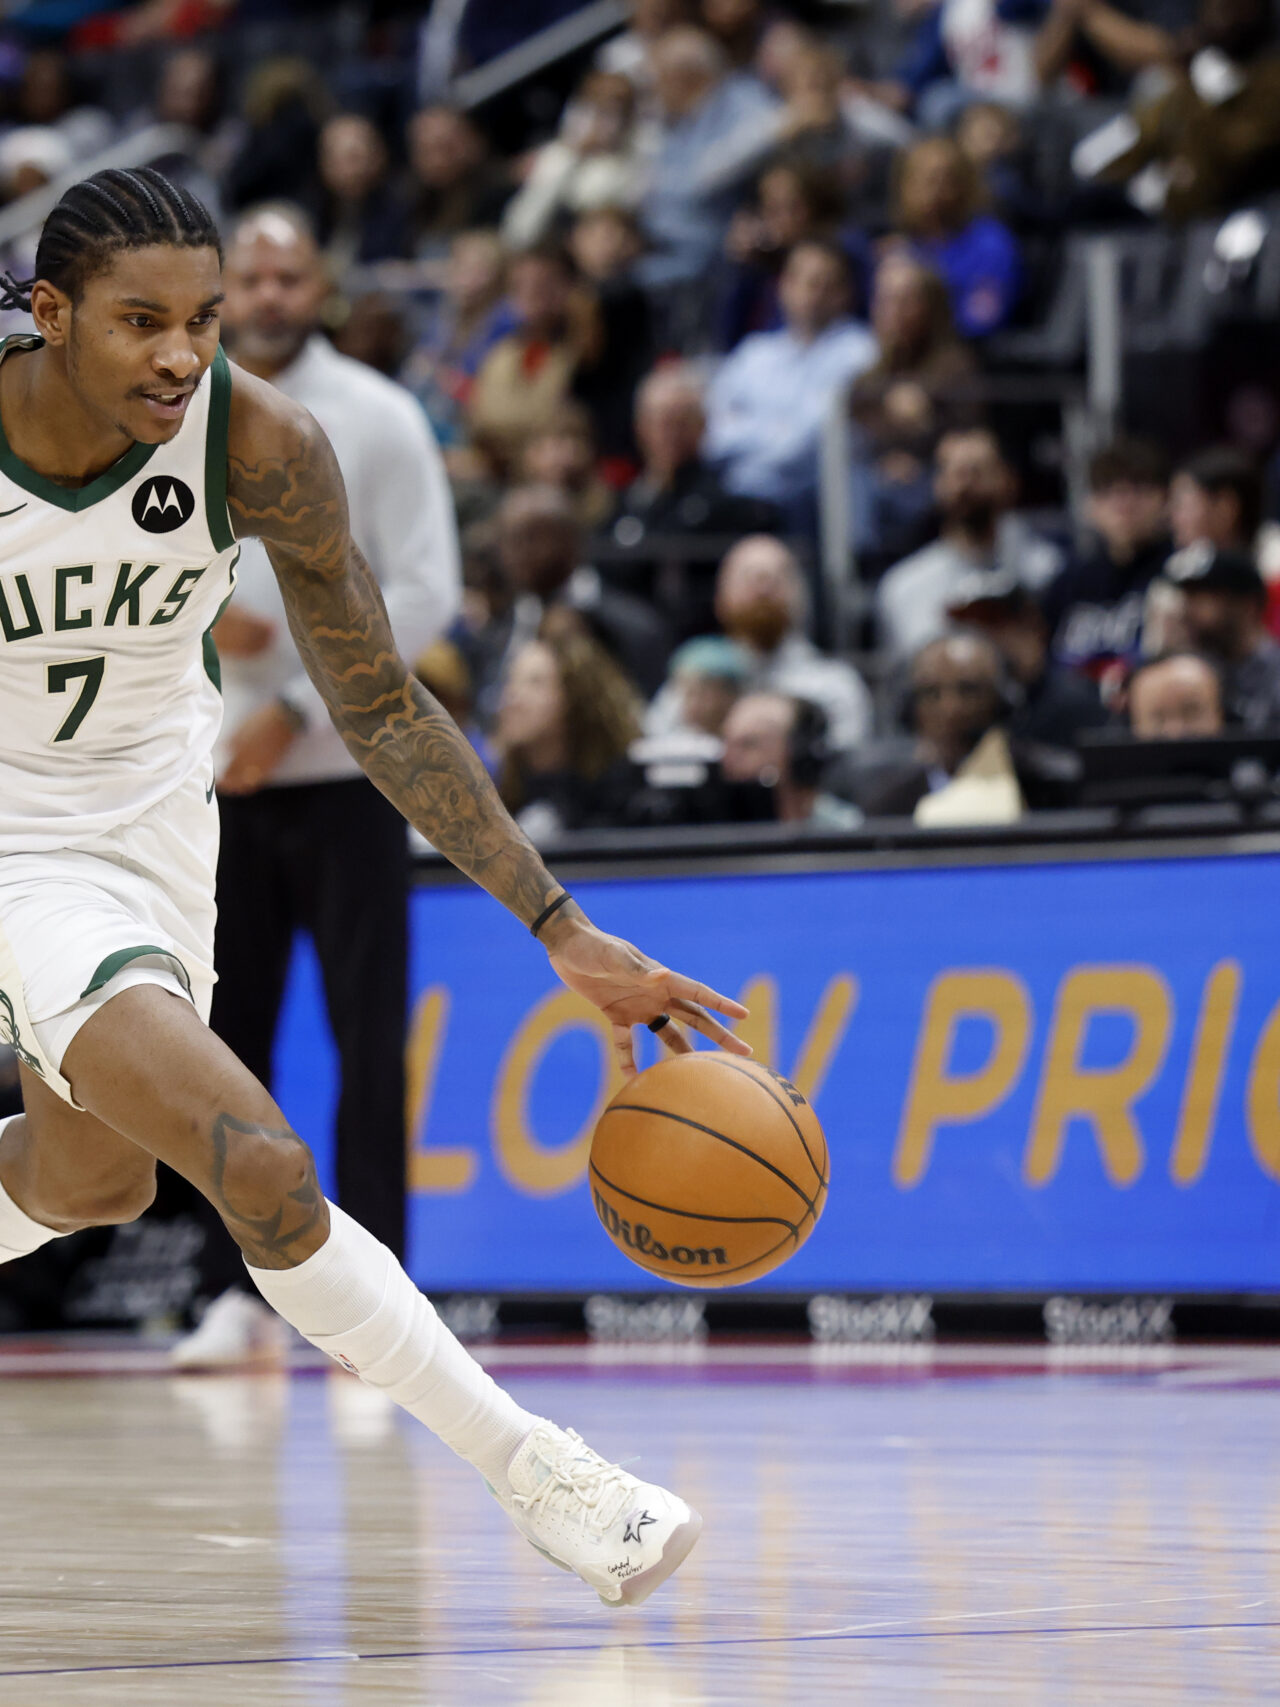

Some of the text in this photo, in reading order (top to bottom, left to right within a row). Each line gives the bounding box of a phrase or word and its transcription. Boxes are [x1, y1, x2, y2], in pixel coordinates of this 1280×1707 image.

[45, 655, 106, 744] 7
[892, 958, 1280, 1191] PRI
[594, 1186, 731, 1267] Wilson
